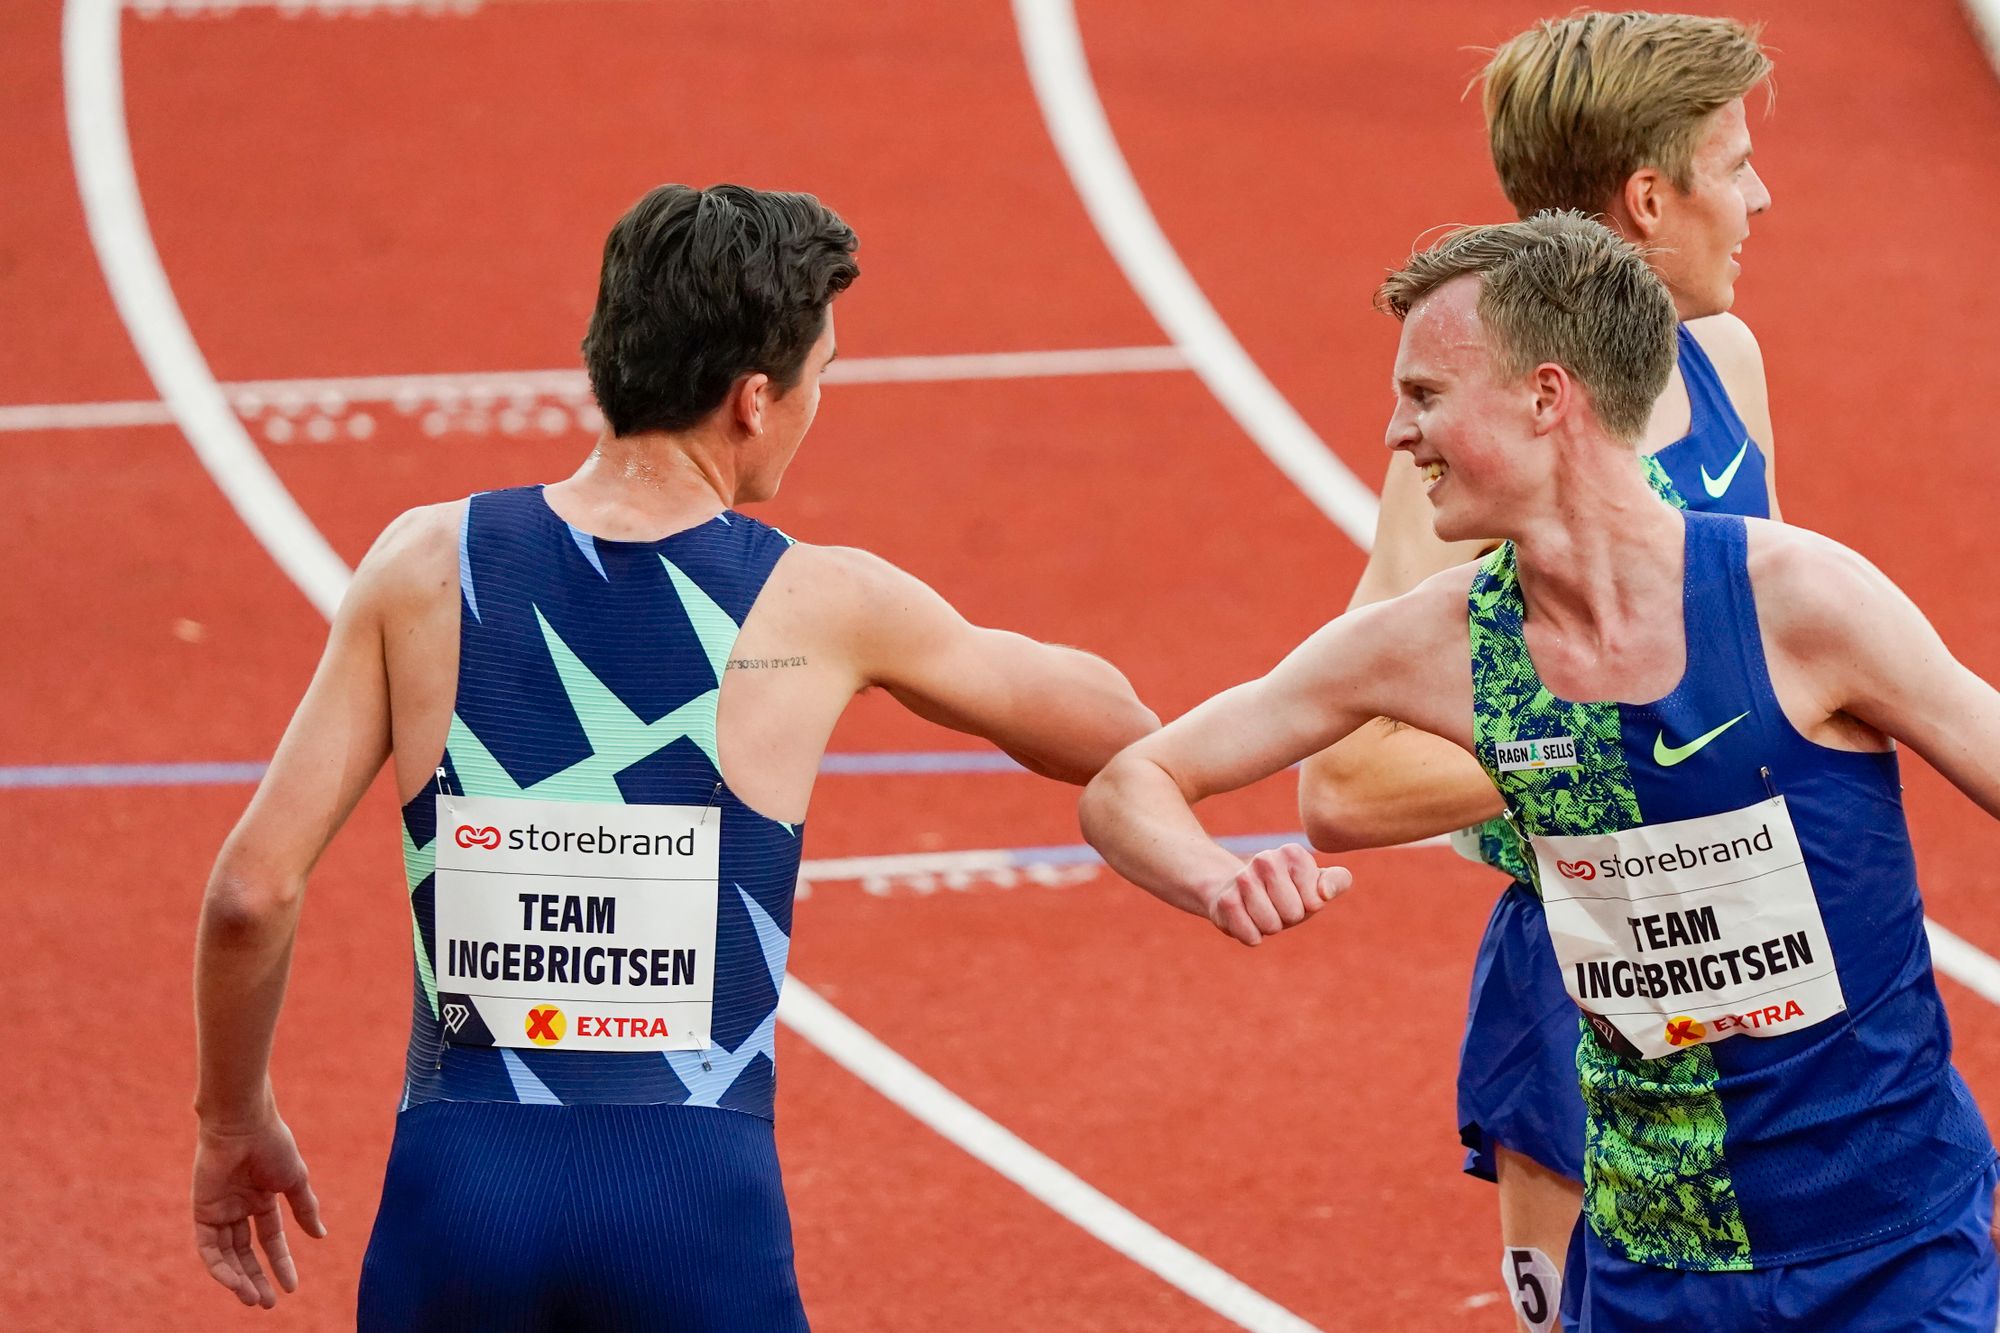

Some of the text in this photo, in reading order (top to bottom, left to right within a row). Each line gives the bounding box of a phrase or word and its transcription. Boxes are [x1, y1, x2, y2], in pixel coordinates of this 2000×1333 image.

[1498, 742, 1575, 764] RAGN SELLS
[508, 824, 695, 856] storebrand
[1599, 823, 1774, 880] storebrand
[518, 893, 616, 934] TEAM
[1627, 905, 1721, 952] TEAM
[448, 939, 697, 987] INGEBRIGTSEN
[1575, 930, 1815, 1000] INGEBRIGTSEN
[577, 1016, 669, 1038] EXTRA
[1712, 999, 1805, 1034] EXTRA
[1511, 1250, 1549, 1324] 5
